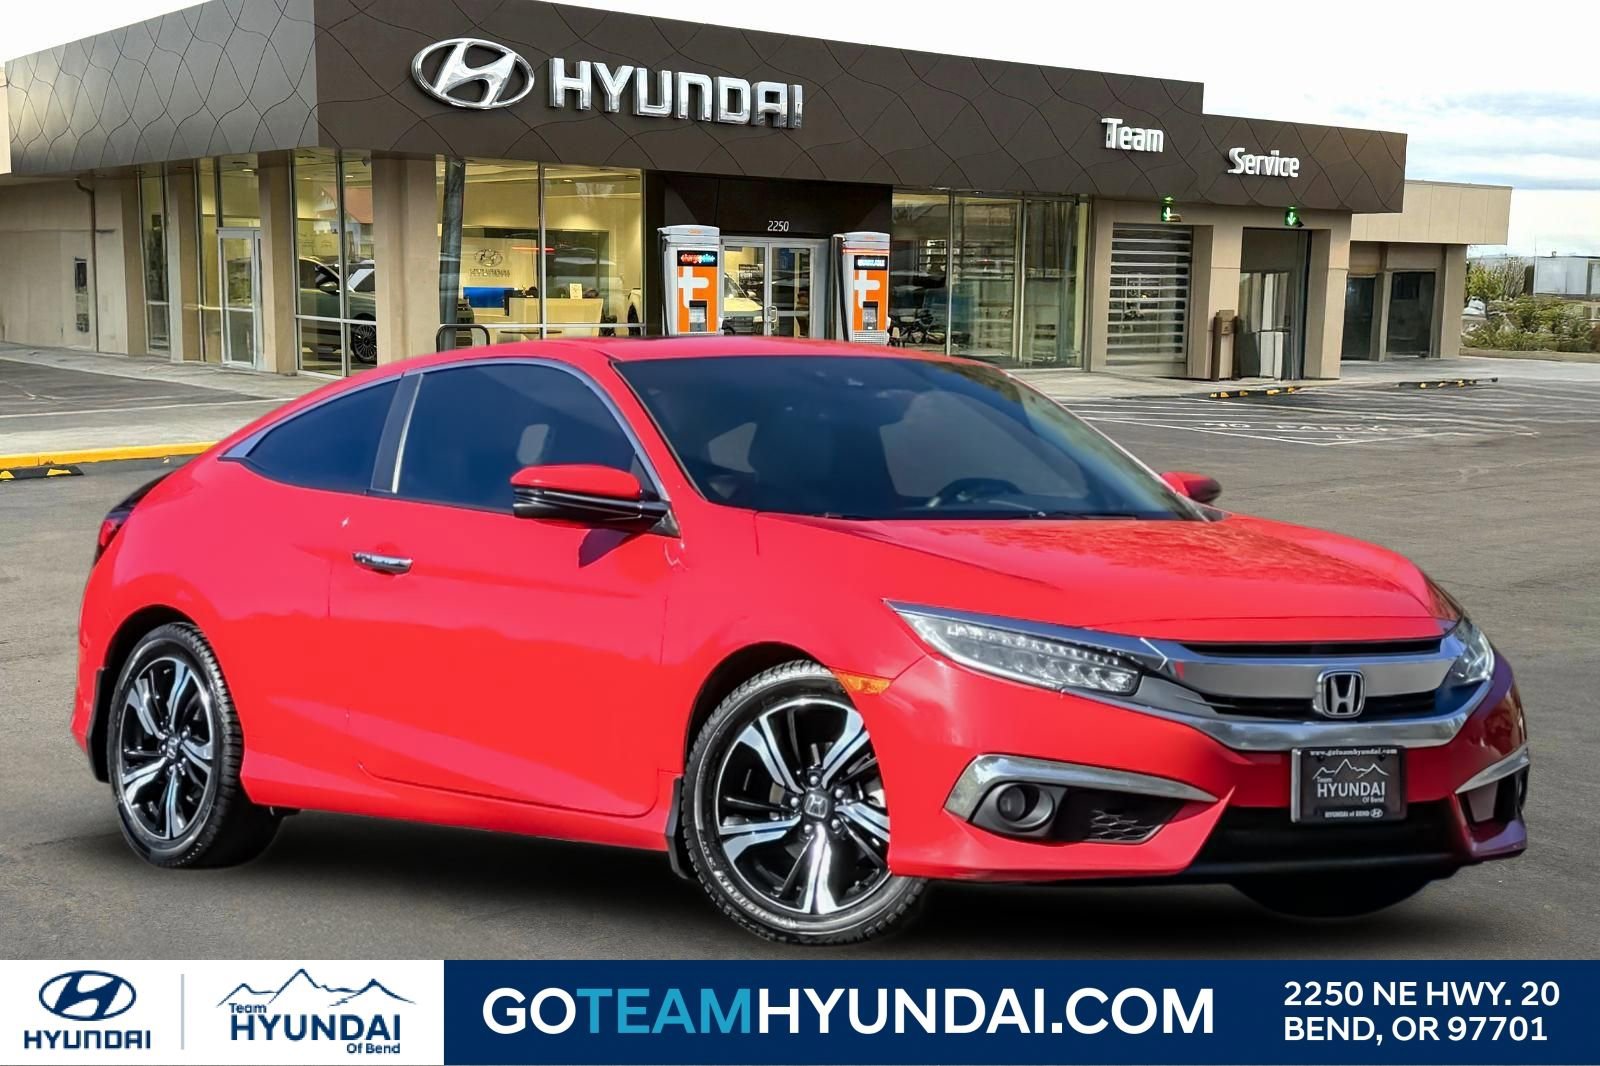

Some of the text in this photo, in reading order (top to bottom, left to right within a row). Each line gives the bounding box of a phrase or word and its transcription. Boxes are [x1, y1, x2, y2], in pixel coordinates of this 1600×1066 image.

[548, 57, 803, 129] HYUNDAI
[1101, 117, 1164, 153] Team
[1227, 147, 1300, 178] Service
[767, 220, 790, 232] 2250
[1317, 782, 1386, 798] HYUNDAI
